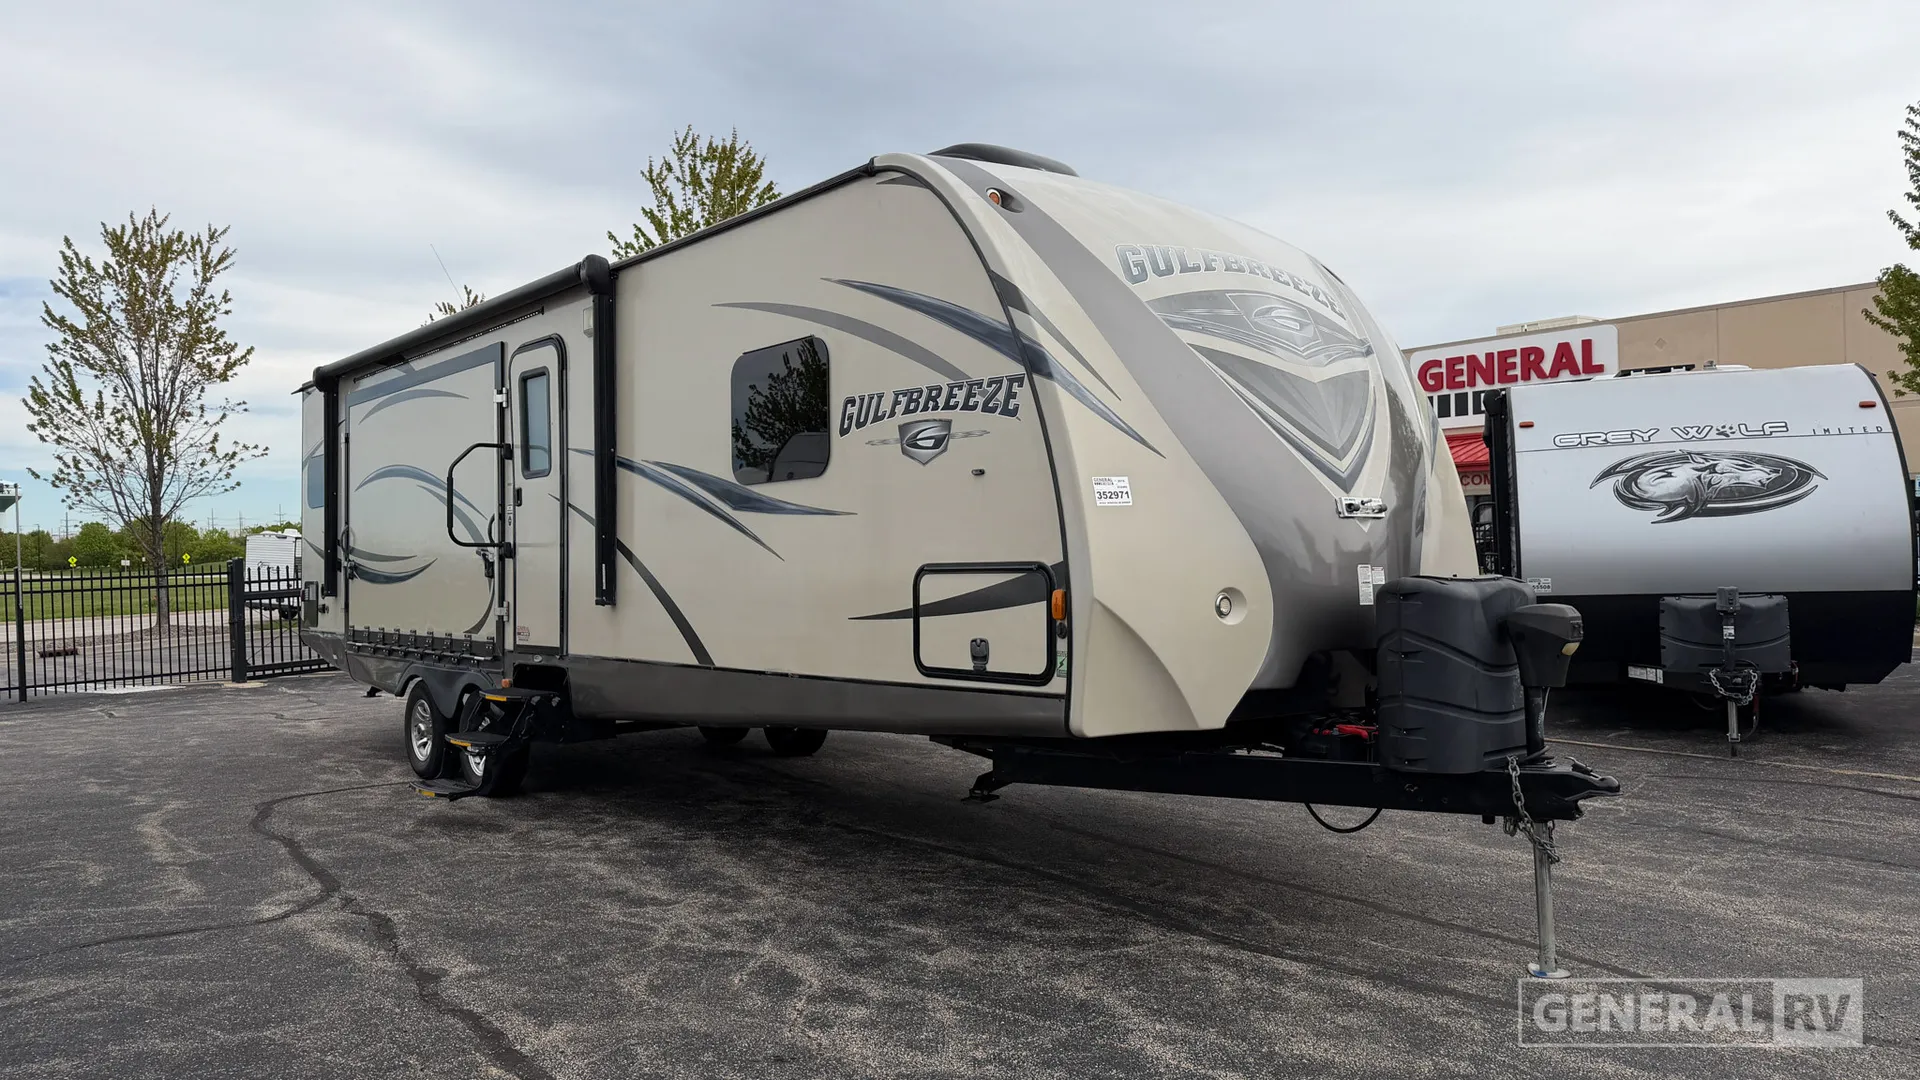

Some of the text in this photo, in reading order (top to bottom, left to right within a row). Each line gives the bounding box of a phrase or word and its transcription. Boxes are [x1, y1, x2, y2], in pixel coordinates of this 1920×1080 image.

[1115, 244, 1347, 321] GULFBREEZE
[1418, 338, 1605, 392] GENERAL
[838, 372, 1026, 438] GULFBREEZE
[1553, 428, 1660, 448] GREY
[1096, 490, 1130, 500] 352971
